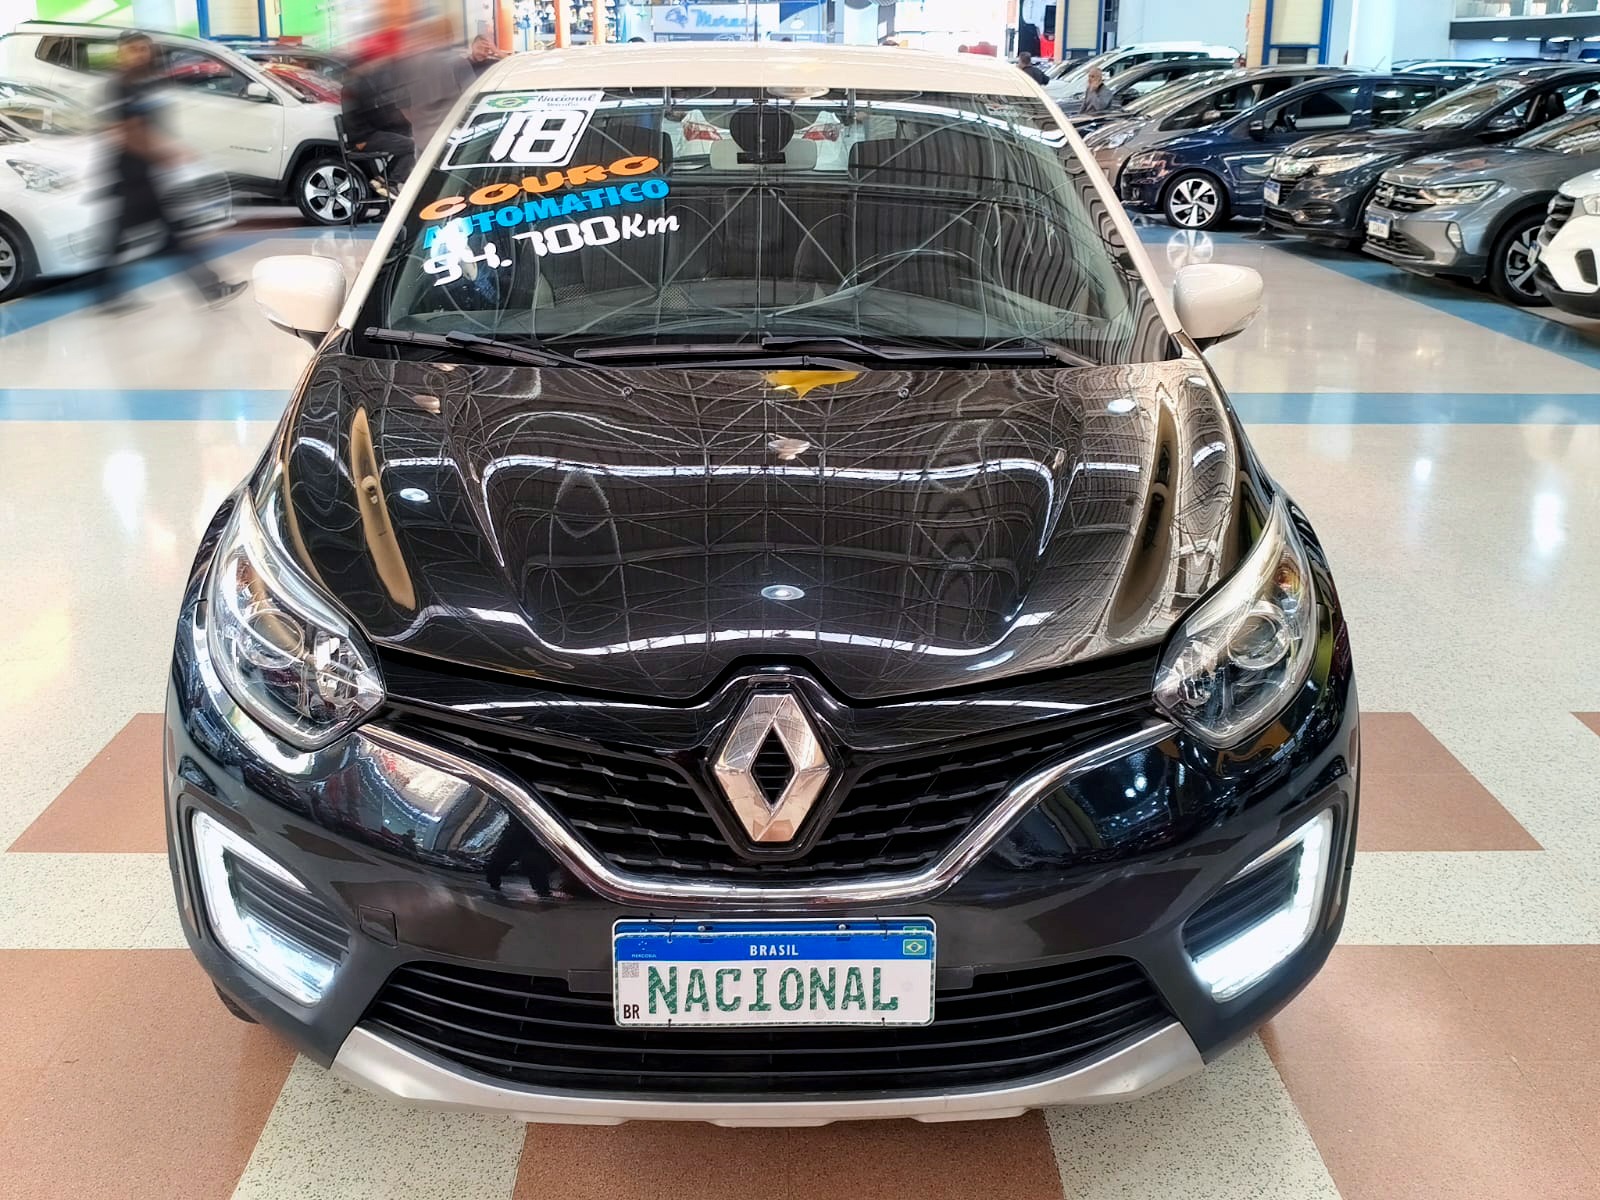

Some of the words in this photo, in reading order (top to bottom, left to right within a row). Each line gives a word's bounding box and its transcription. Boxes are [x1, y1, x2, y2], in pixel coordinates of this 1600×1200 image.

[489, 111, 585, 163] 18
[419, 156, 660, 220] COURO
[750, 944, 799, 957] BRASIL
[623, 1004, 640, 1019] BR
[647, 965, 899, 1014] NACIONAL
